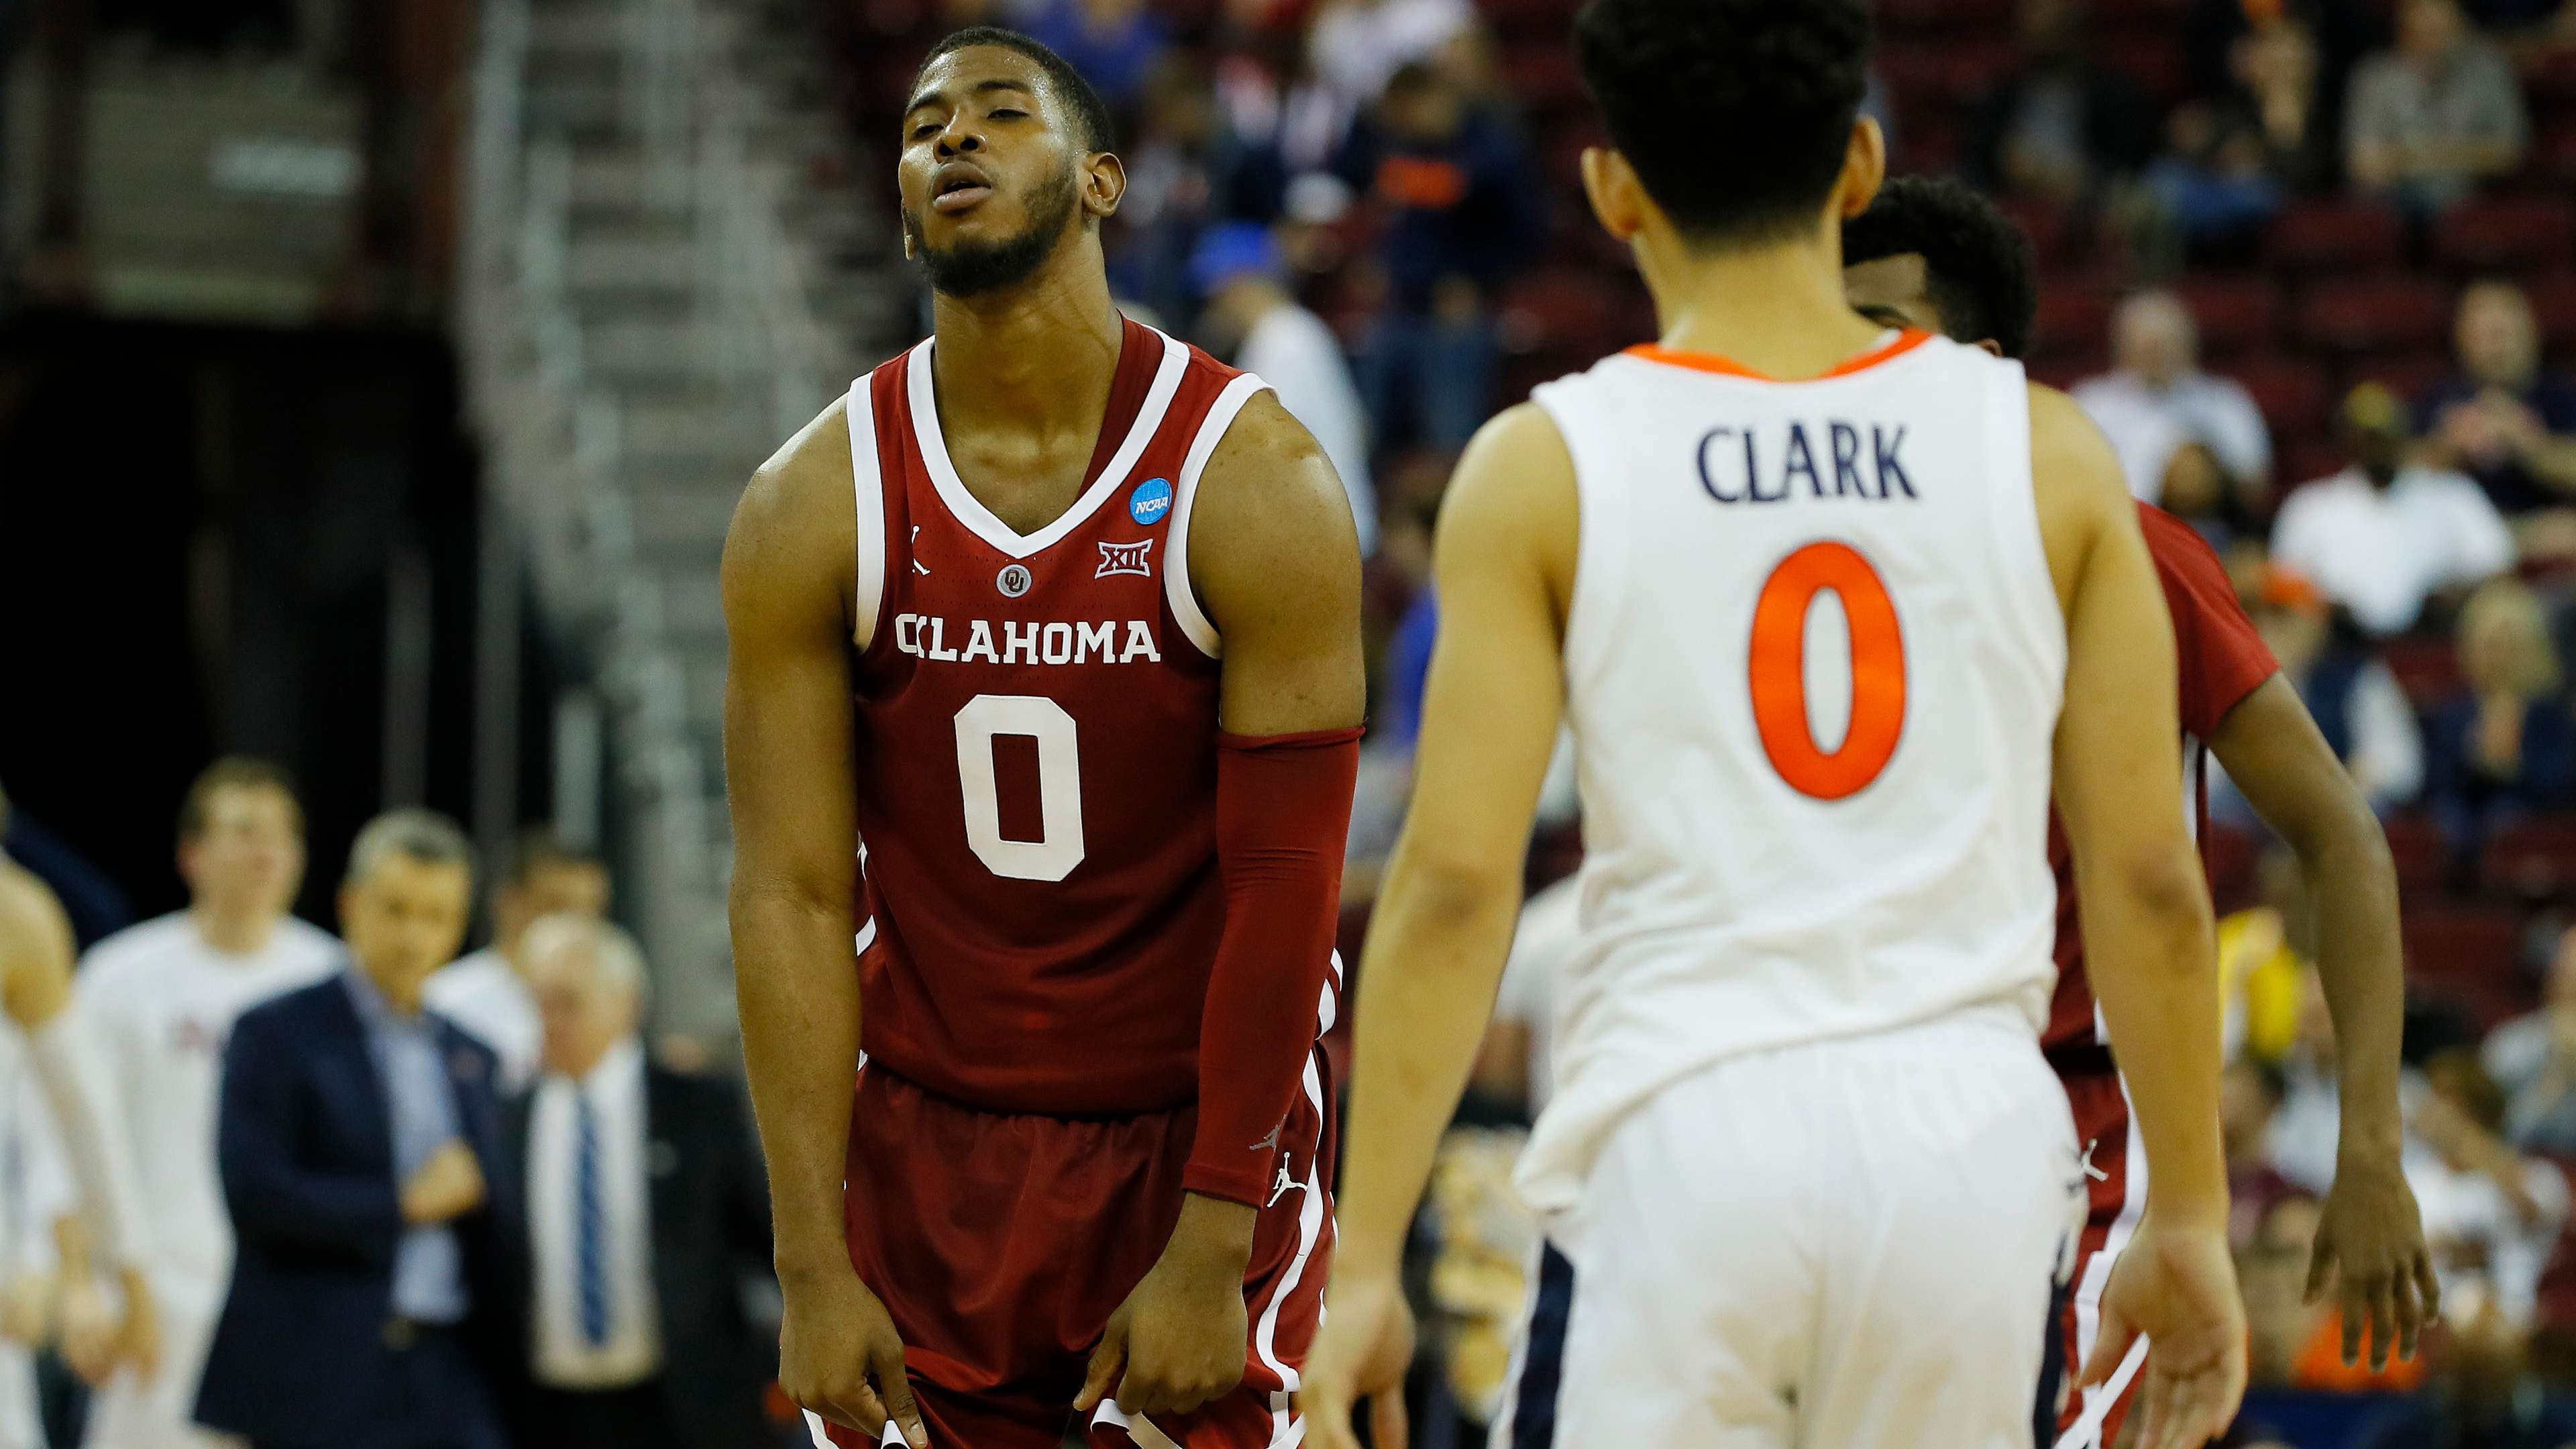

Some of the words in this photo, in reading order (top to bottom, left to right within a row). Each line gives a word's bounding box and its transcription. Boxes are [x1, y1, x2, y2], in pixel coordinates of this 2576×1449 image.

[1696, 419, 1919, 503] CLARK
[1135, 496, 1169, 515] NCAA
[1098, 542, 1150, 575] XII
[1748, 540, 1907, 801] 0
[953, 694, 1085, 883] 0
